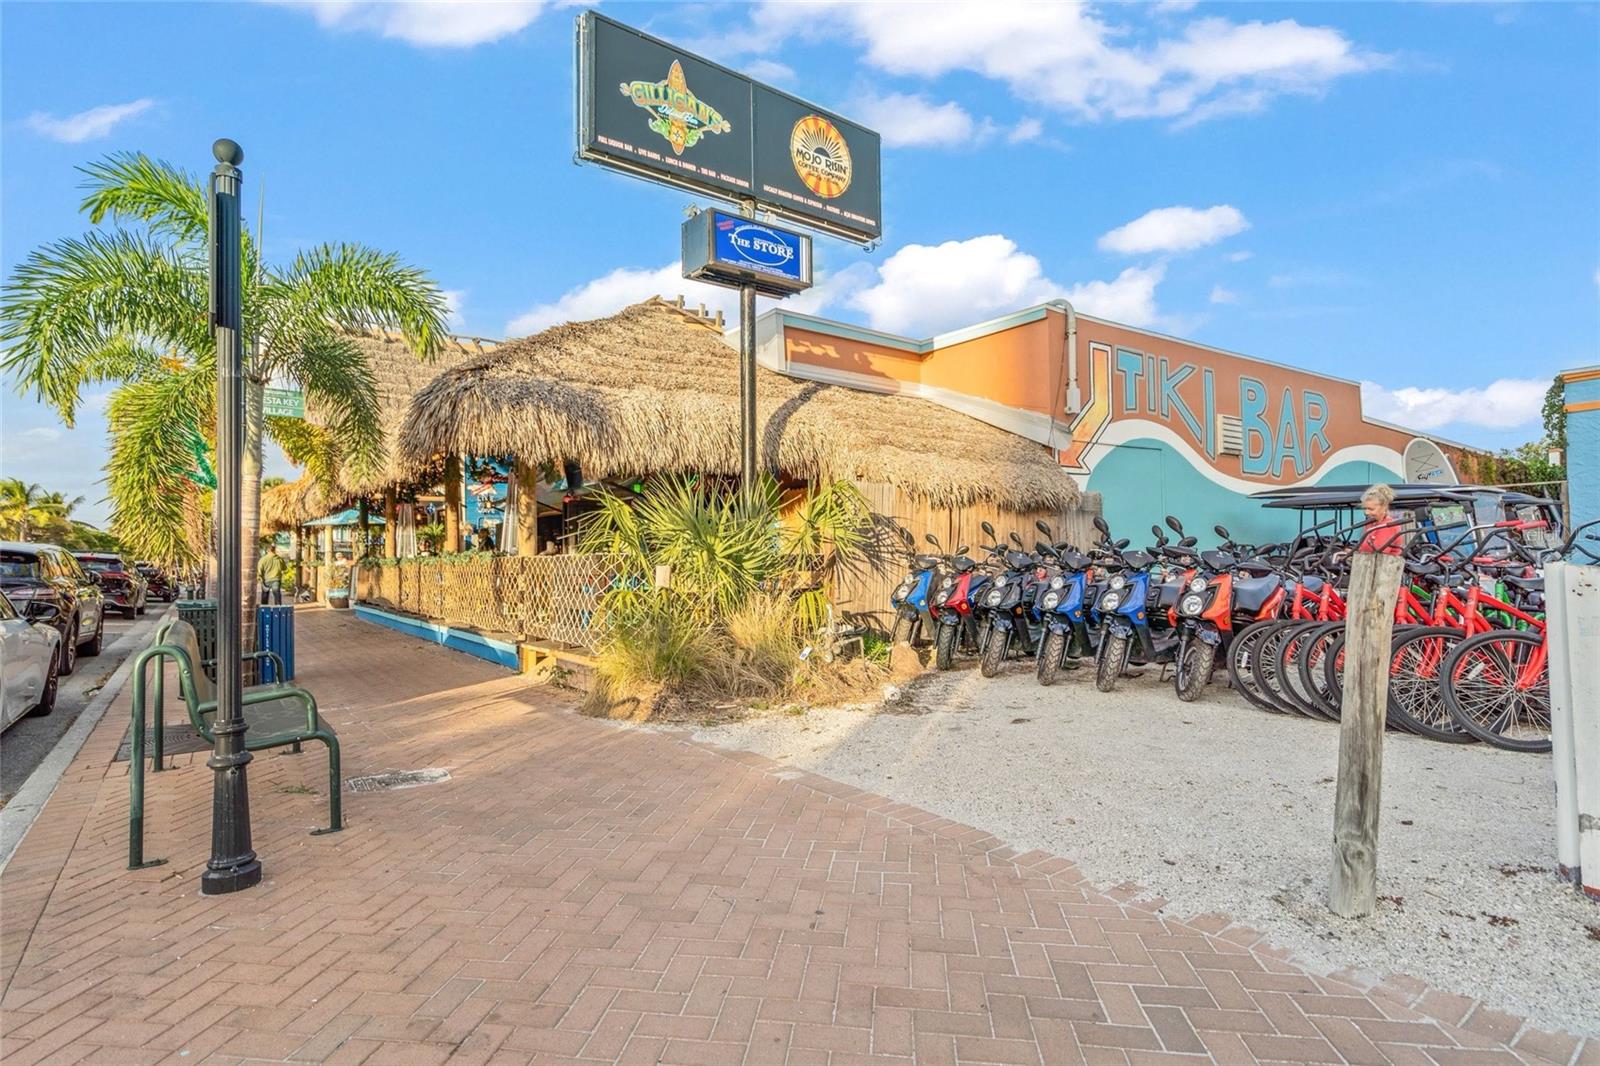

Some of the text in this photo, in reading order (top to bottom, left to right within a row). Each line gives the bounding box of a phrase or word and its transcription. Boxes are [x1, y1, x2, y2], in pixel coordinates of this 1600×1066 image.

[632, 83, 722, 132] GILLIGAN'S
[796, 148, 822, 165] MOJO
[797, 160, 819, 173] COFFEE
[821, 168, 847, 183] COMPANY
[753, 239, 794, 260] STORE
[283, 398, 299, 407] KEY
[1116, 347, 1333, 479] TIKI BAR
